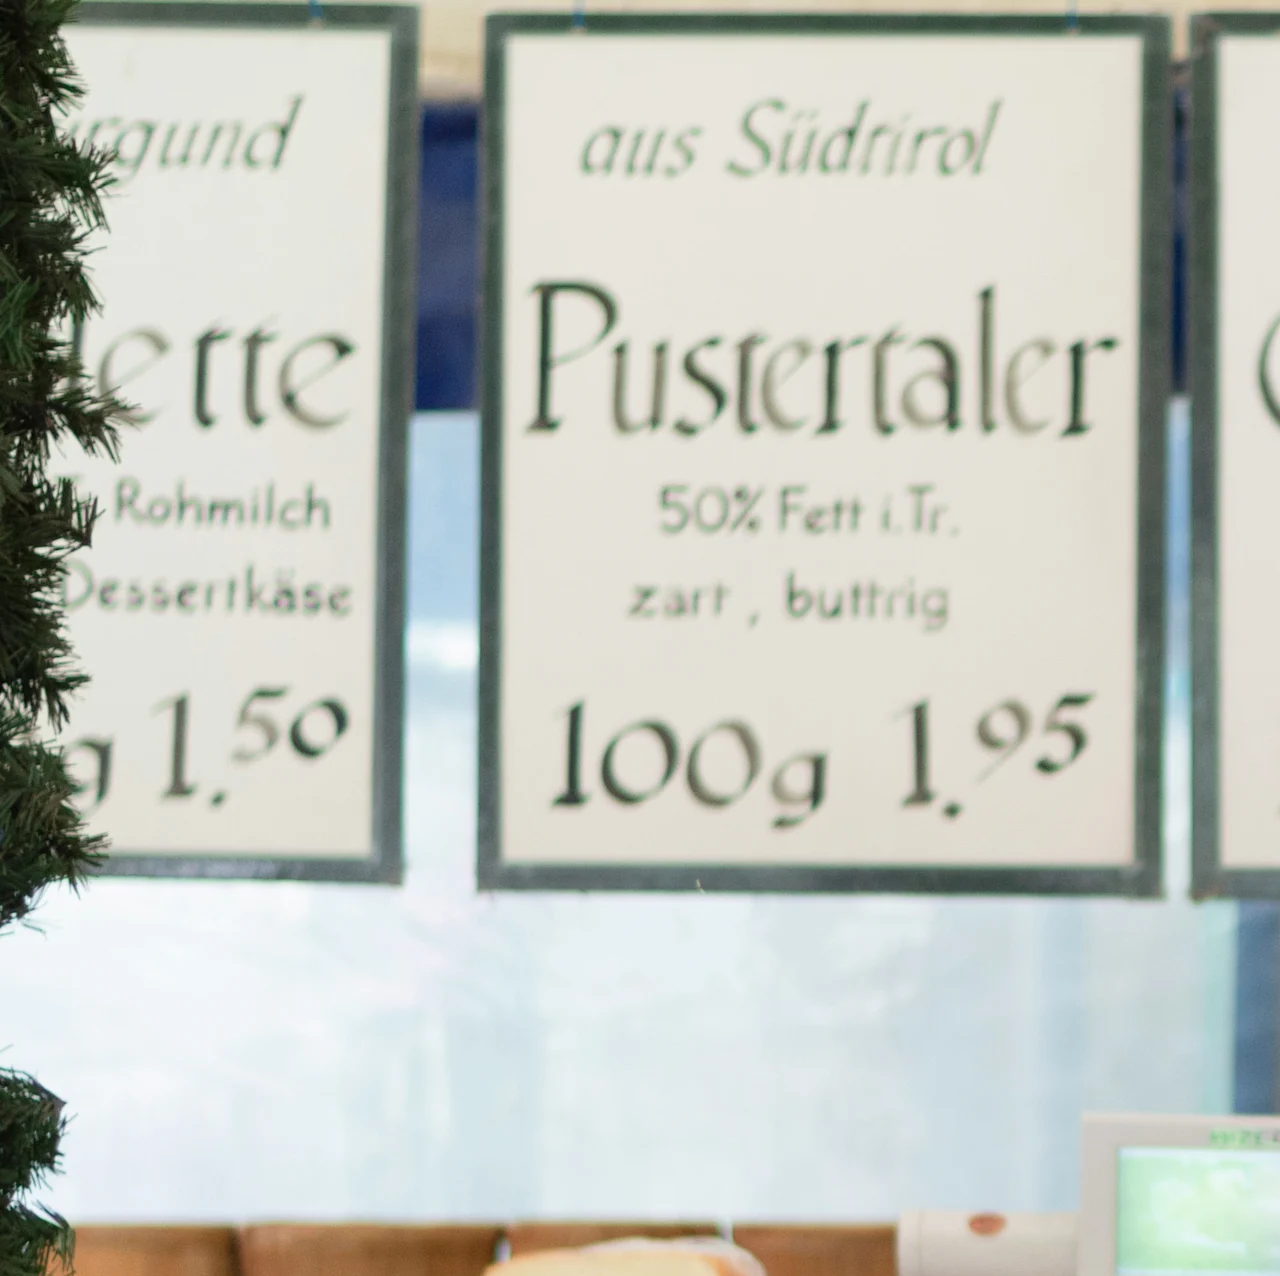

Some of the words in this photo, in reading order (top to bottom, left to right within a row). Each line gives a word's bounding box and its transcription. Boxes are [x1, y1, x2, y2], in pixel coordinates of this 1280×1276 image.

[578, 124, 704, 180] aus
[723, 97, 1004, 180] Südtirol
[523, 278, 1124, 442] Pustertaler
[113, 476, 333, 532] Rohmilch
[658, 483, 766, 537] 50%
[777, 484, 864, 537] Fett
[62, 556, 355, 614] Dessertkäse
[784, 570, 950, 634] buttrig
[549, 699, 829, 830] 100g
